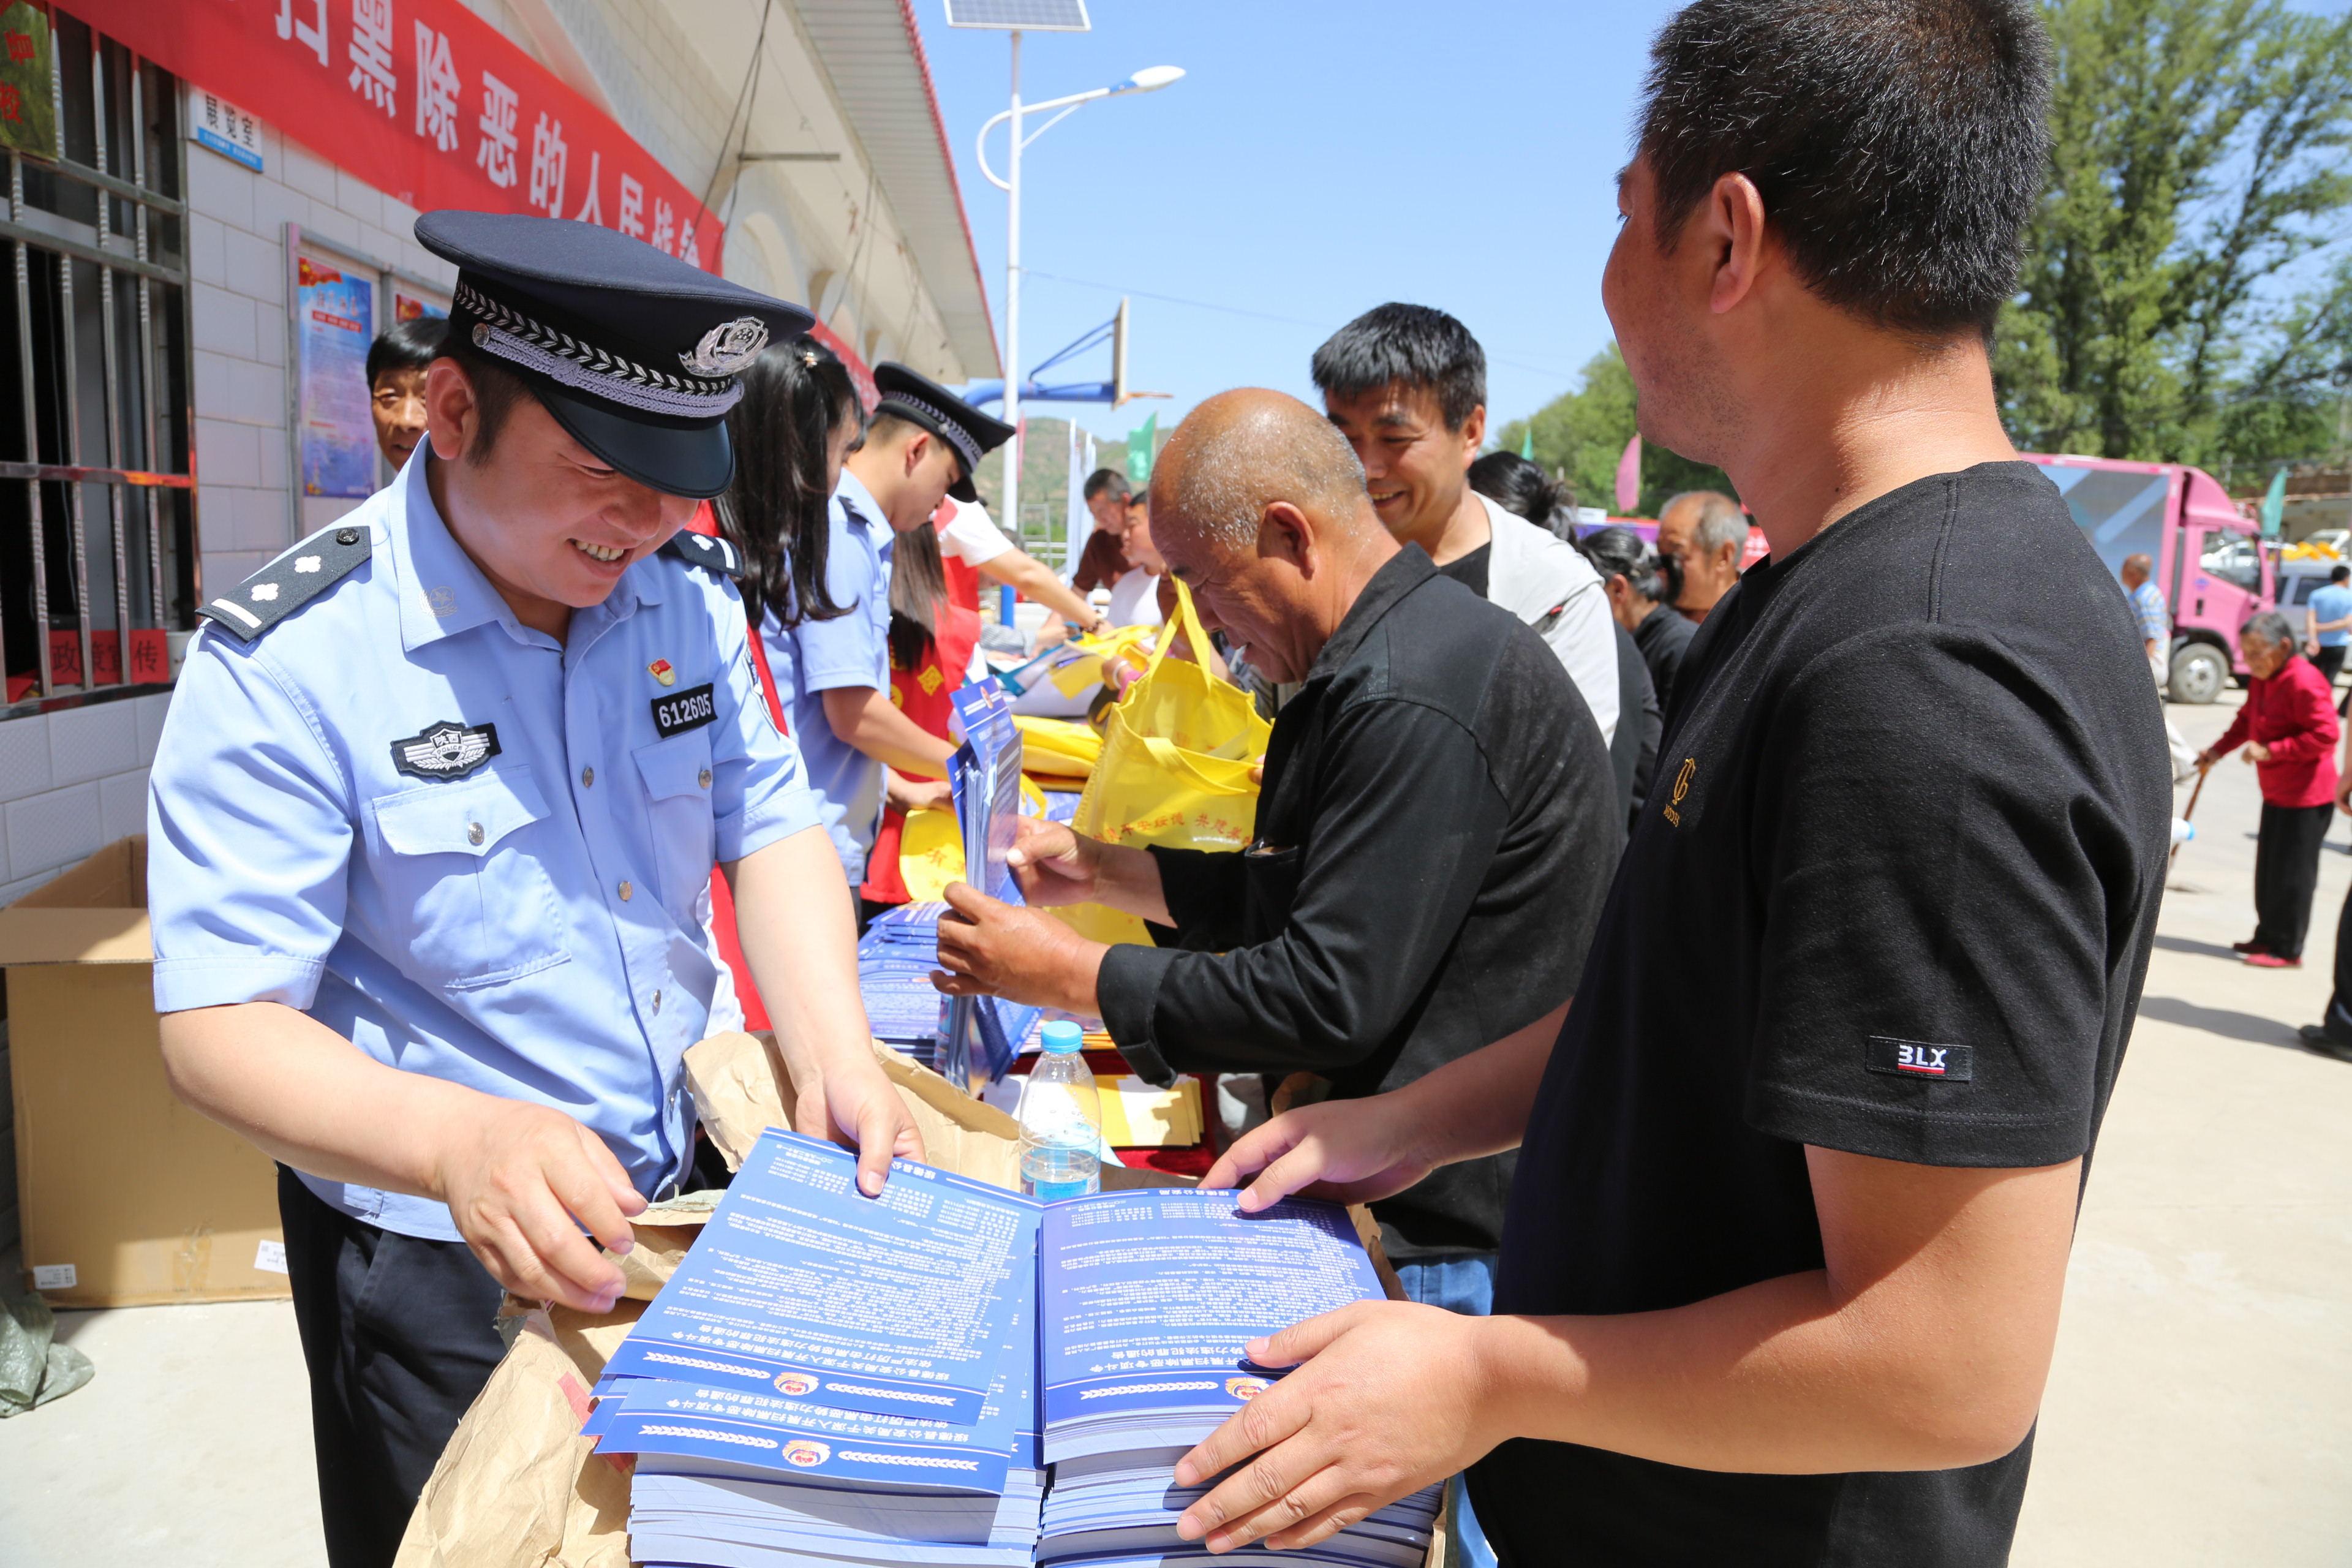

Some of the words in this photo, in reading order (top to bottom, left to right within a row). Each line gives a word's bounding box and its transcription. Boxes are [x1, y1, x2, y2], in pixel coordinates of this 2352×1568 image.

[658, 693, 711, 728] 612605
[434, 734, 459, 747] 陕西
[436, 744, 462, 754] POLICE
[671, 1330, 950, 1381] 绥德县公安局关于深入开展扫黑除恶专项斗争
[698, 1324, 932, 1368] 依法严厉打击黑恶势力违法犯罪的通告
[666, 1398, 970, 1443] 绥德县公安局关于深入开展扫黑除恶专项斗争
